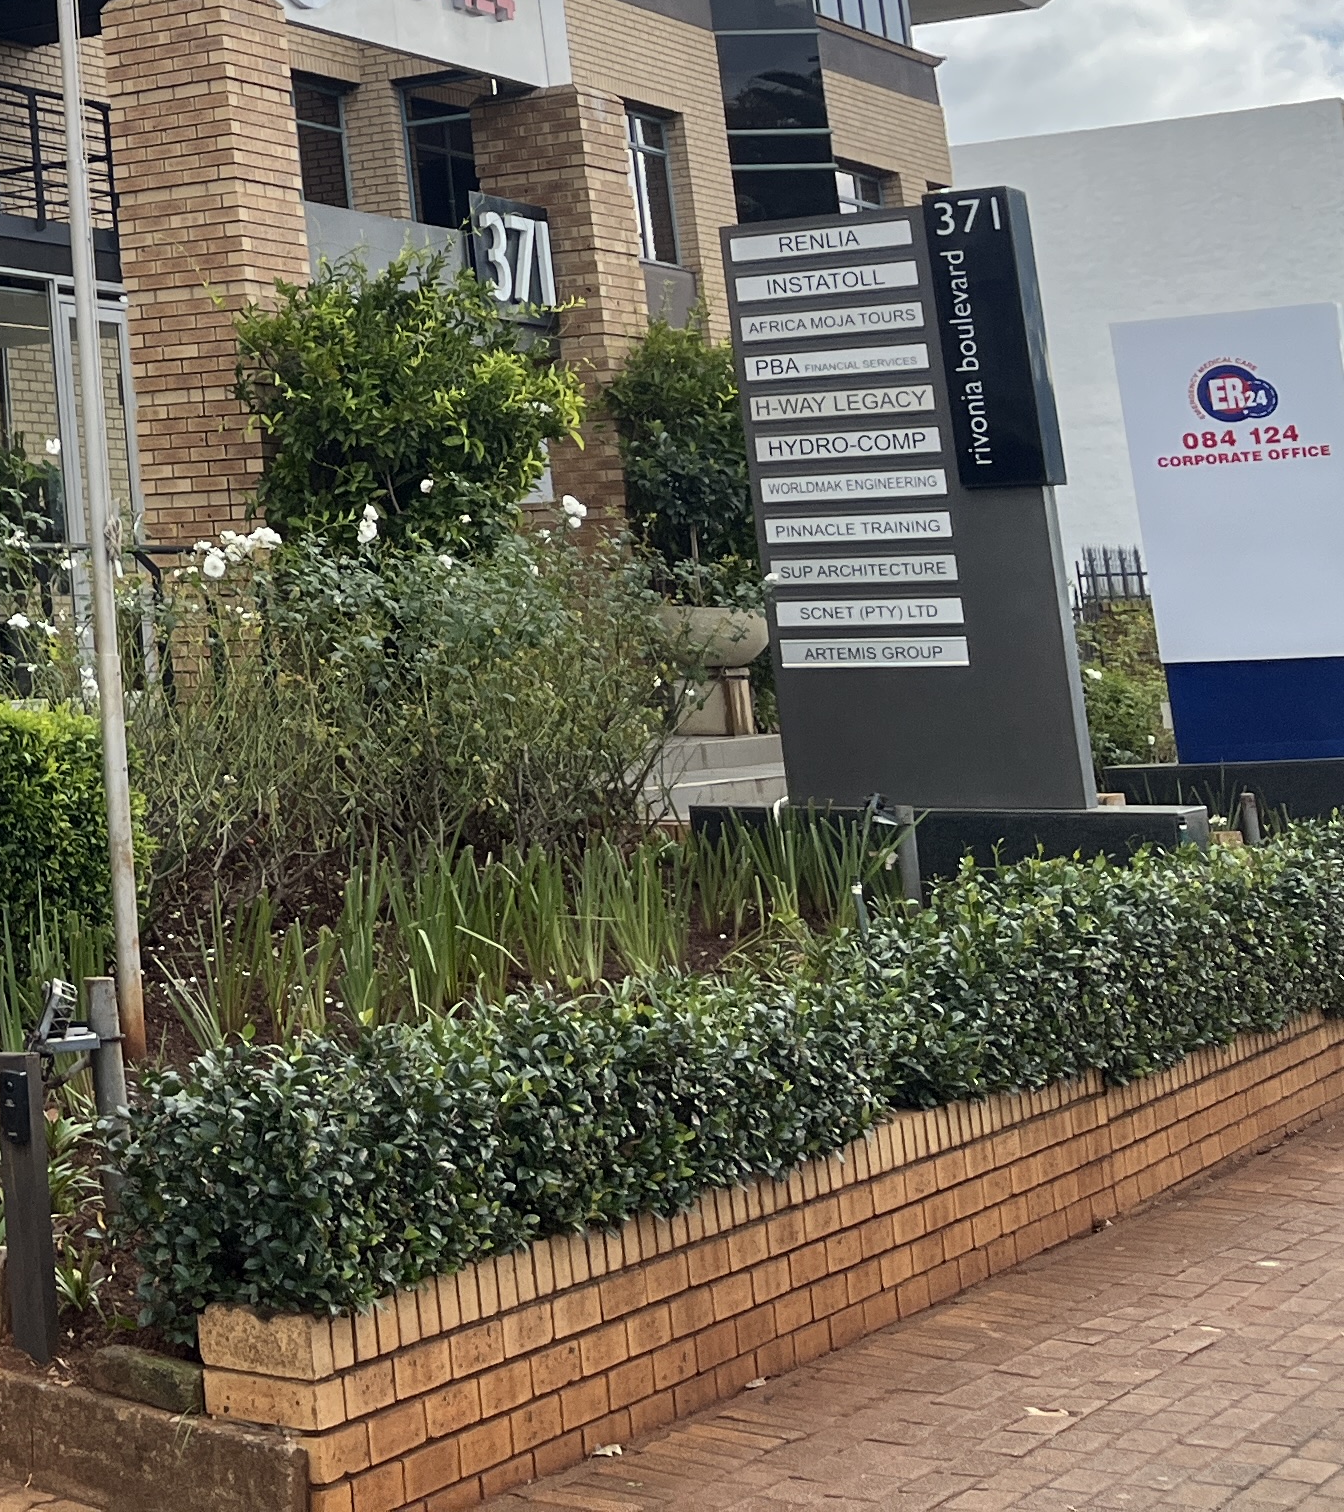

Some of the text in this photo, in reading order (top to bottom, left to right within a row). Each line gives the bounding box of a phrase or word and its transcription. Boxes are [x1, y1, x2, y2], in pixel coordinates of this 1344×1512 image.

[933, 196, 1002, 236] 371
[778, 230, 860, 254] RENLIA
[479, 211, 556, 307] 371
[766, 269, 886, 296] INSTATOLL
[748, 308, 916, 334] AFRICA MOJA TOURS
[755, 356, 918, 376] PBA FINANCIAL SERVICES
[940, 249, 993, 466] rivonia boulevard
[755, 389, 927, 417] H-WAY LEGACY
[768, 432, 926, 456] HYDRO-COMP
[1182, 424, 1299, 450] 084 124
[1158, 445, 1331, 468] CORPORATE OFFICE
[768, 474, 938, 496] WORLDMAK ENGINEERING
[776, 519, 941, 538] PINNACLE TRAINING
[780, 561, 948, 580] SUP ARCHITECTURE
[800, 604, 938, 622] SCNET (PTY) LTD
[804, 646, 944, 660] ARTEMIS GROUP
